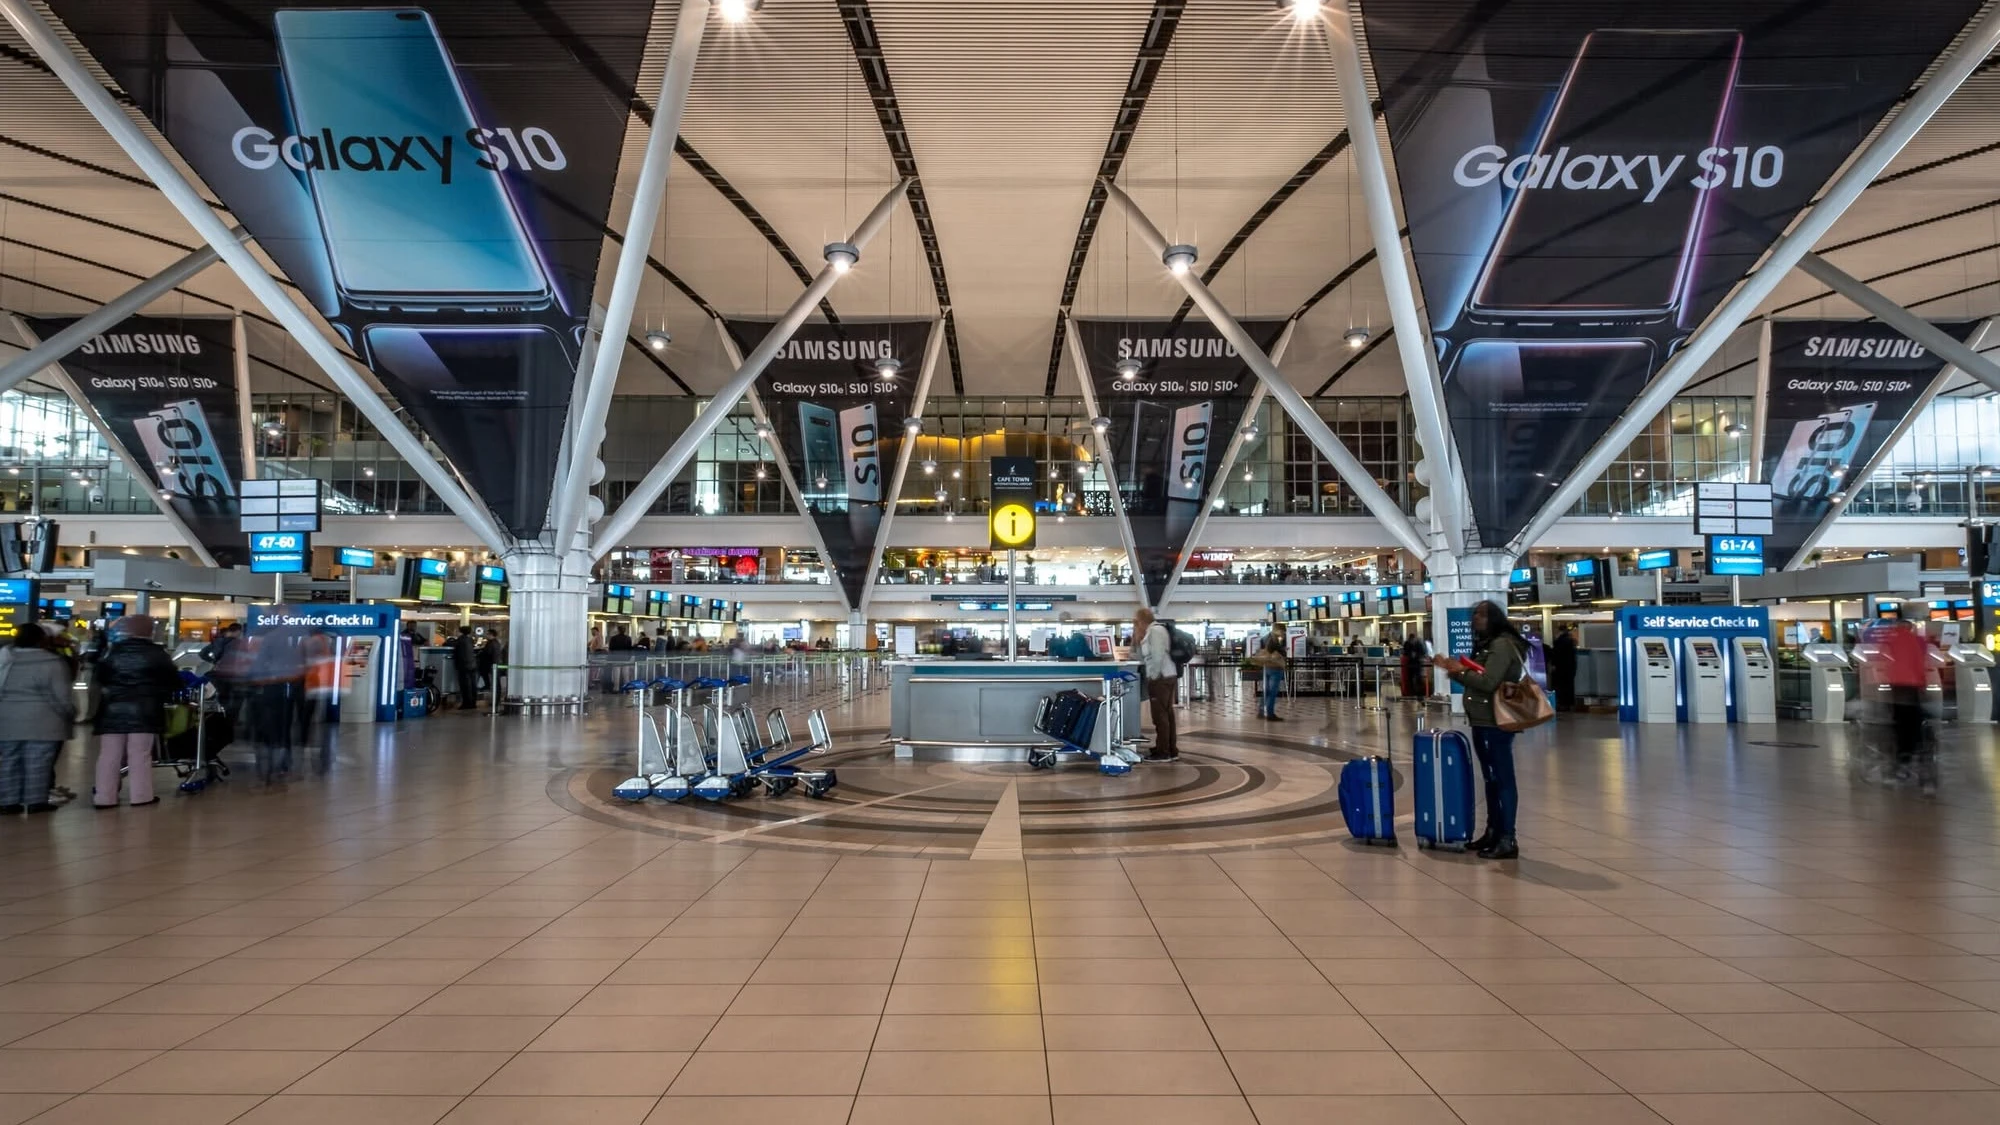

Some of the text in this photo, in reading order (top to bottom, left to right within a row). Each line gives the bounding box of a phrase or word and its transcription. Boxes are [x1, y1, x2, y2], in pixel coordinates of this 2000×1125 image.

[231, 126, 567, 184] Galaxy S10
[1452, 144, 1784, 203] Galaxy S10
[1804, 336, 1925, 359] SAMSUNG
[91, 377, 136, 391] Galaxy
[167, 377, 189, 388] S10
[192, 378, 218, 389] S10+
[772, 382, 899, 397] Galaxy S10e S10 S10+
[1112, 380, 1239, 395] Galaxy S10e S10 S10+
[1787, 379, 1833, 394] Galaxy
[1862, 380, 1883, 392] S10
[1886, 380, 1912, 392] S10+
[851, 423, 879, 486] S10
[1720, 539, 1756, 551] 61-74
[1201, 552, 1234, 561] WIMPY
[1567, 563, 1578, 574] 74
[257, 614, 373, 626] Self Service Check In
[1643, 616, 1759, 628] Self Service Check In
